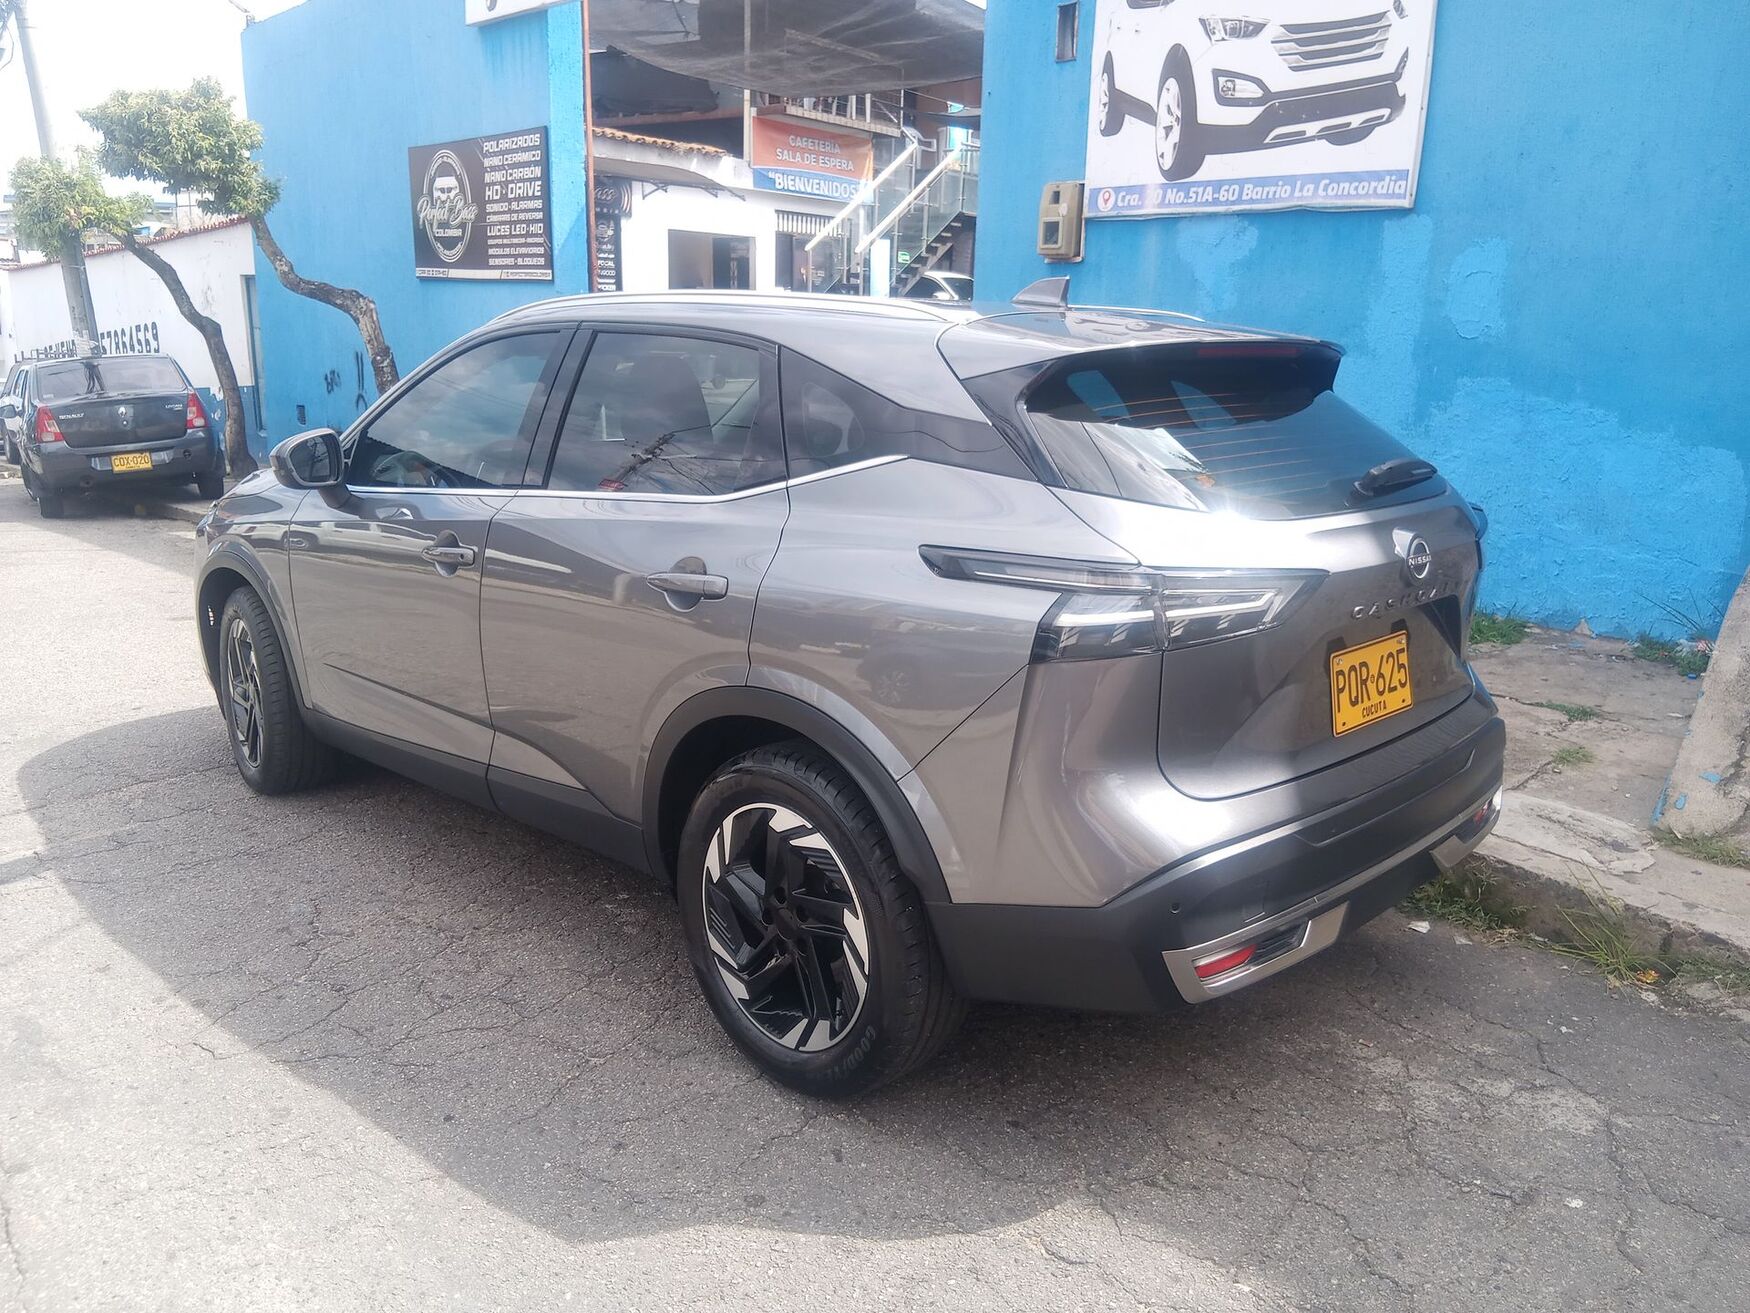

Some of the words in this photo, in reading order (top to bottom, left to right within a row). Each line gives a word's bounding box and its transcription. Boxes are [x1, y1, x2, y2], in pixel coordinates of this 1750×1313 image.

[483, 134, 540, 153] POLARIZADOS
[484, 156, 503, 168] NANO
[776, 148, 802, 162] SALA
[804, 153, 817, 165] DE
[819, 155, 855, 171] ESPERA
[485, 170, 506, 183] NANO
[507, 181, 542, 198] DRIVE
[1116, 191, 1142, 207] Cra.
[1241, 181, 1291, 200] Barrio
[1294, 180, 1313, 197] La
[1318, 174, 1407, 196] Concordia
[487, 225, 510, 236] LUCES
[511, 224, 527, 235] LED
[1361, 703, 1387, 718] CUCUTA
